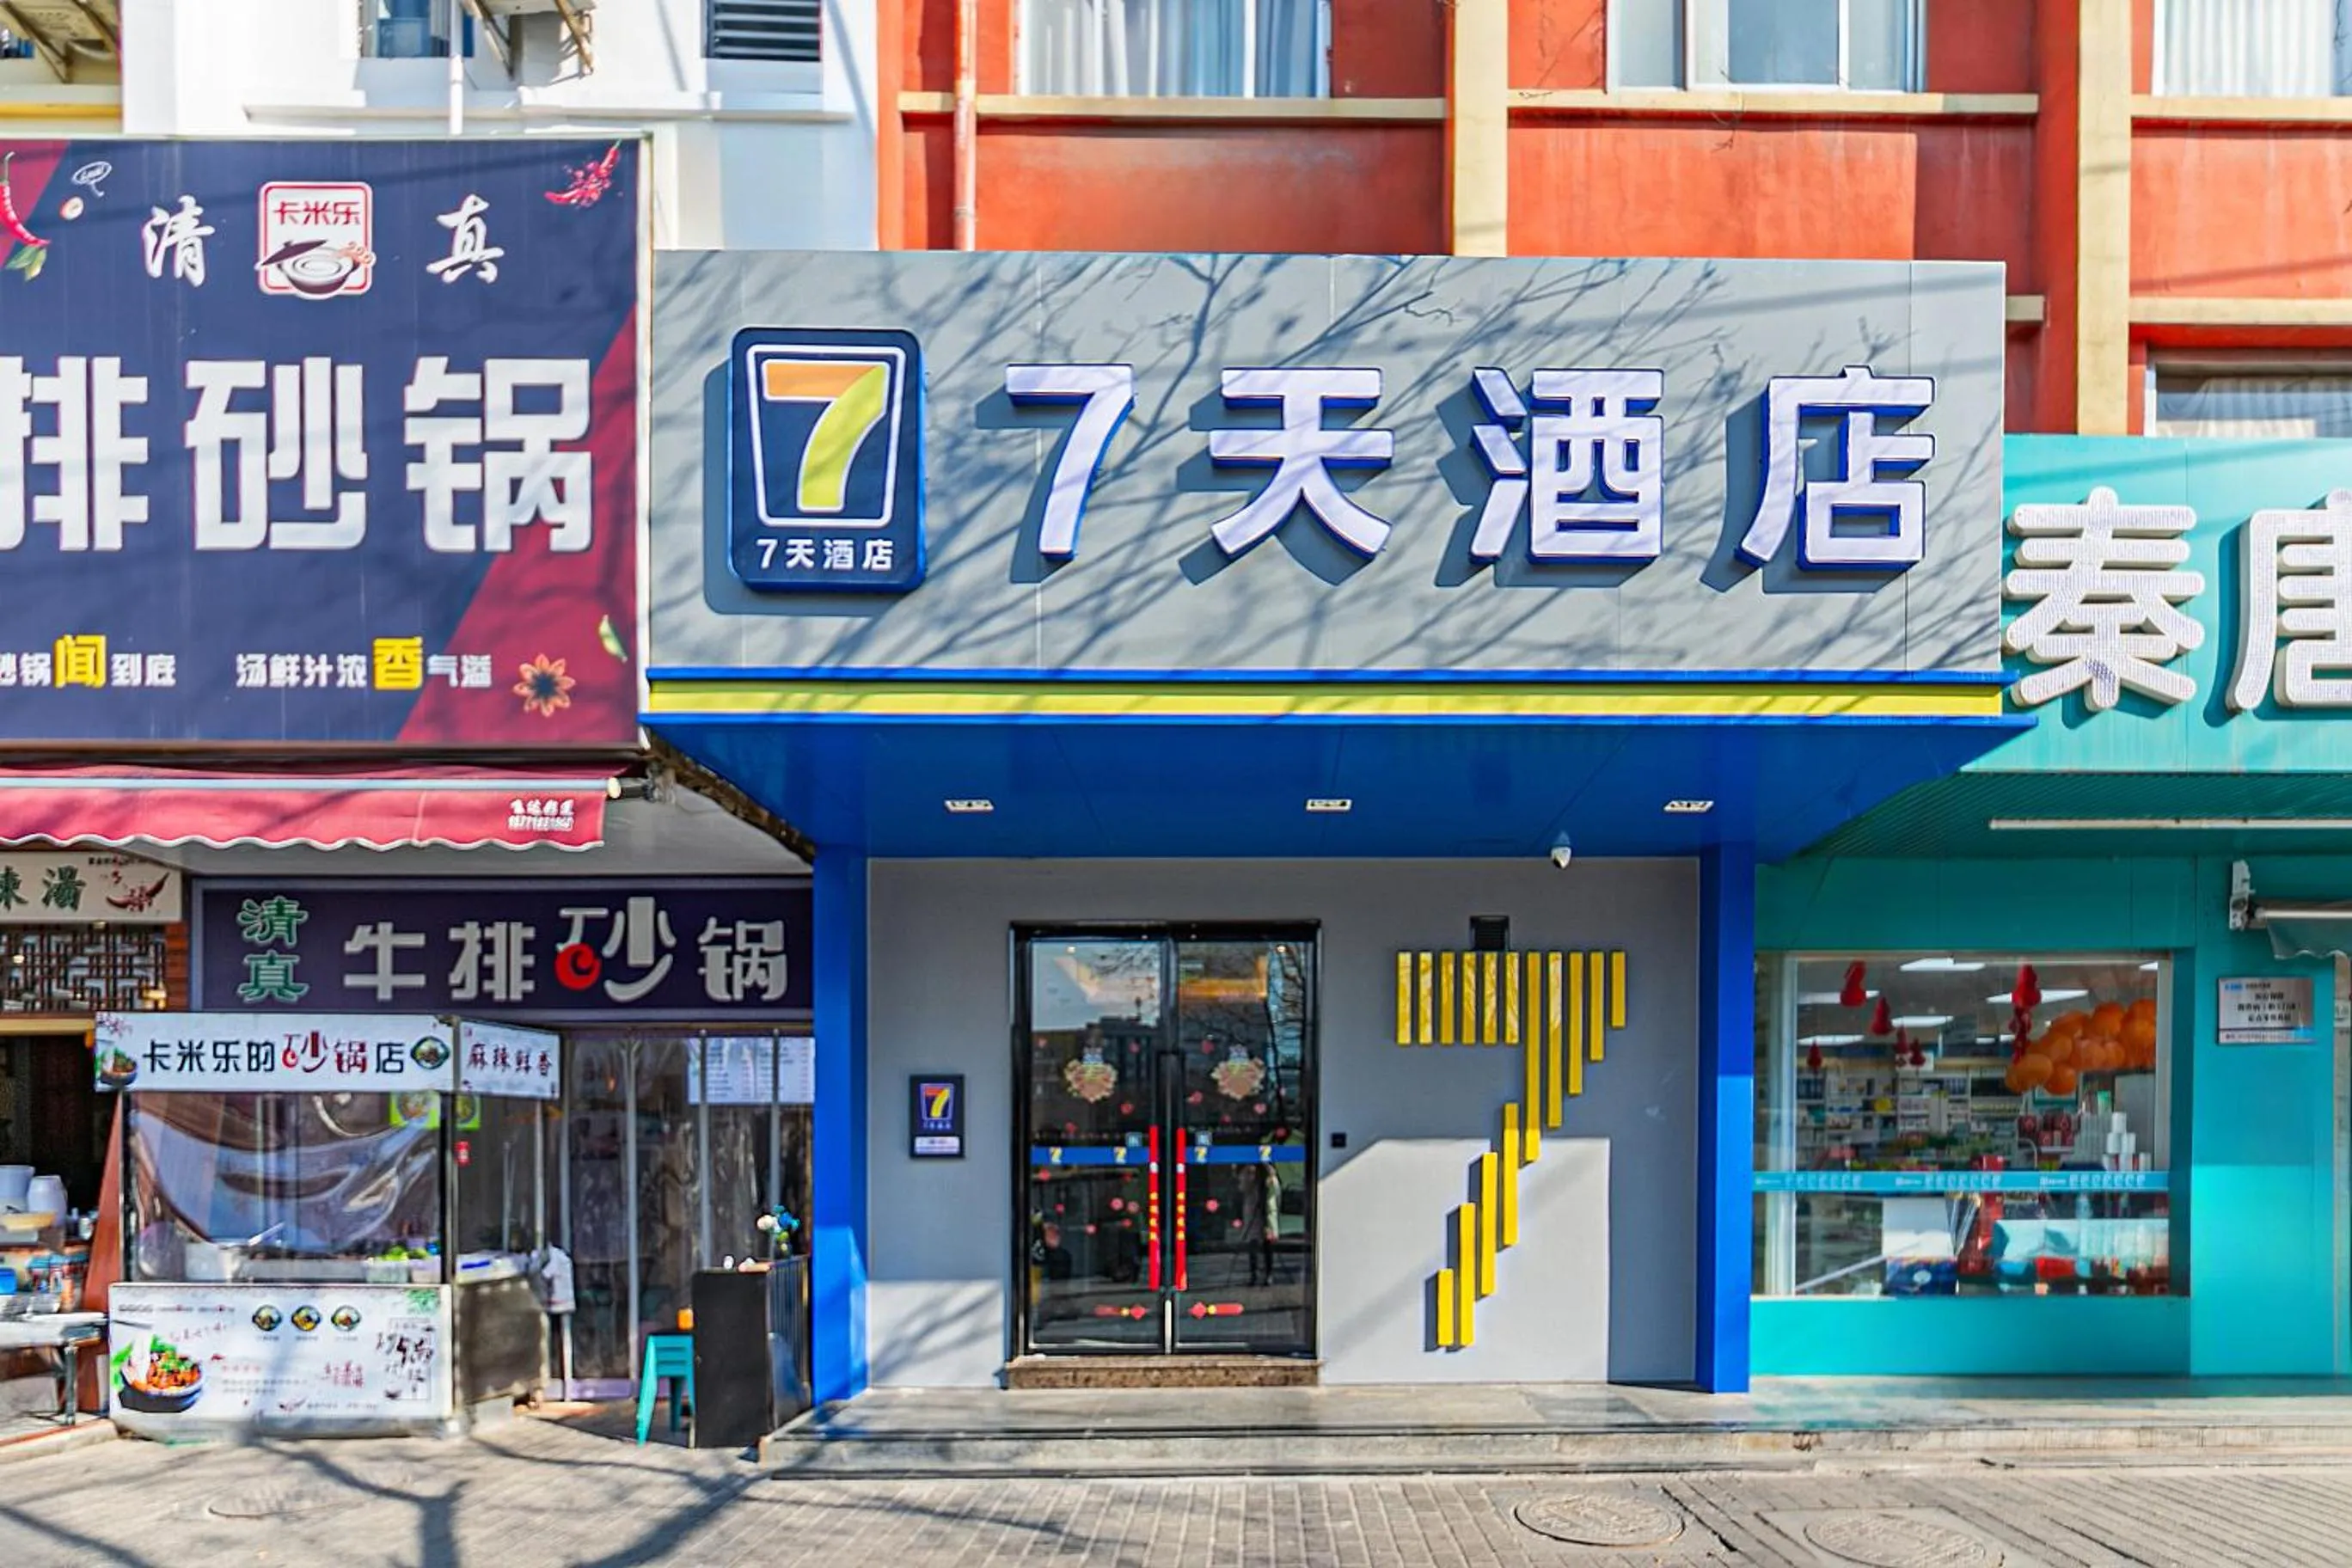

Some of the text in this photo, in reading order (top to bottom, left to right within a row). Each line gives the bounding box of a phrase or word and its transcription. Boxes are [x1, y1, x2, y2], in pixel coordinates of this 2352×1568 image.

[142, 194, 215, 287] 清
[273, 200, 361, 227] 卡米乐
[426, 193, 505, 285] 真
[0, 356, 592, 554] 排砂锅
[1005, 364, 1937, 572] 7天酒店
[756, 537, 894, 572] 7天酒店
[235, 636, 493, 691] 汤鲜汁浓香气溢
[237, 895, 309, 1004] 清真
[344, 896, 789, 1002] 牛排砂锅
[142, 1030, 407, 1075] 卡米乐的砂锅店
